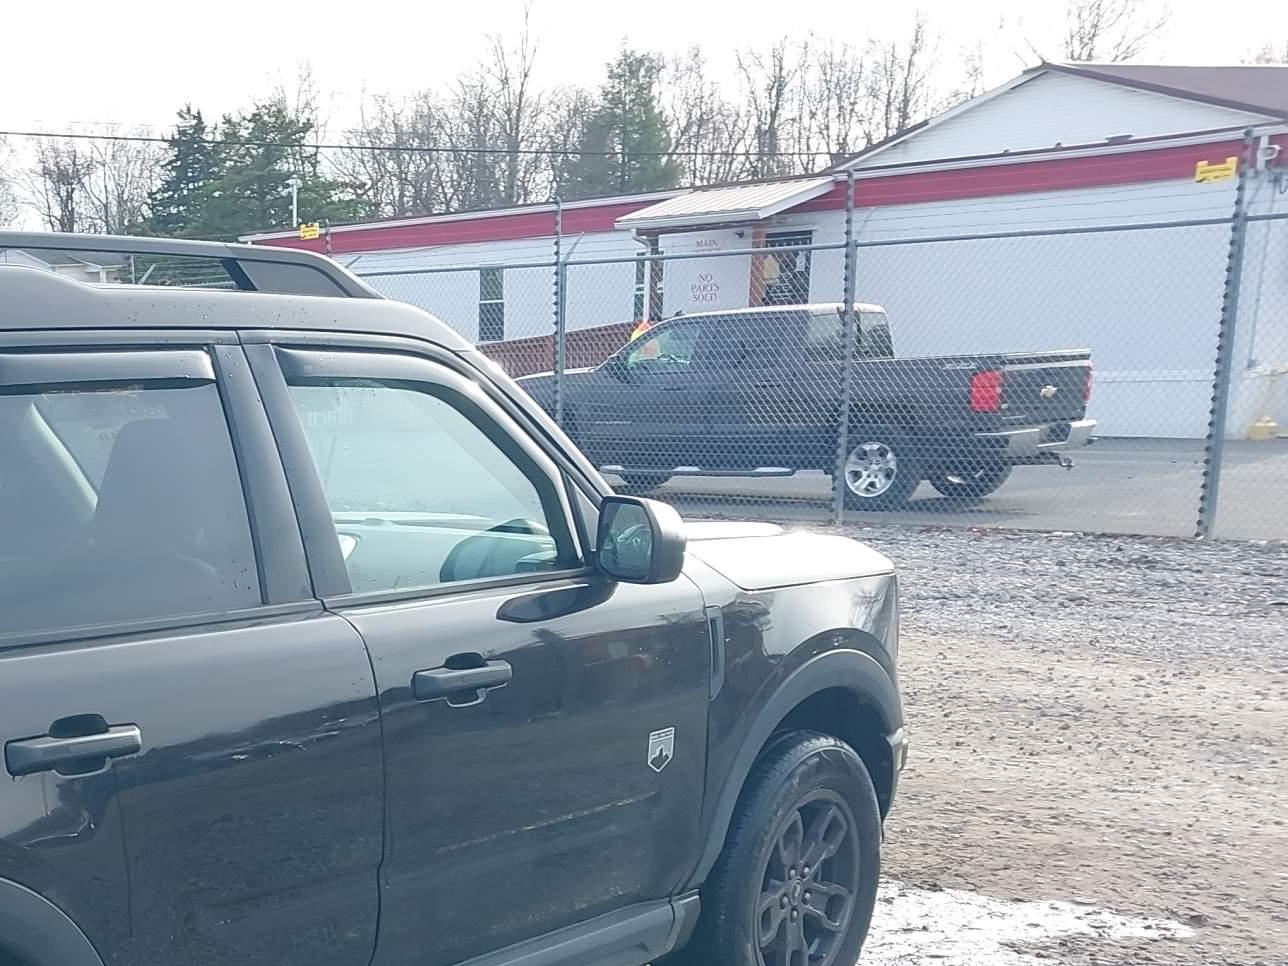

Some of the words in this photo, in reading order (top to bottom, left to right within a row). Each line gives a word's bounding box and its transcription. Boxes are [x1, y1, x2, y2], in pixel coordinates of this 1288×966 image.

[695, 239, 719, 248] MAIN
[697, 273, 713, 283] NO
[691, 283, 720, 293] PARTS
[692, 292, 718, 303] SOLD
